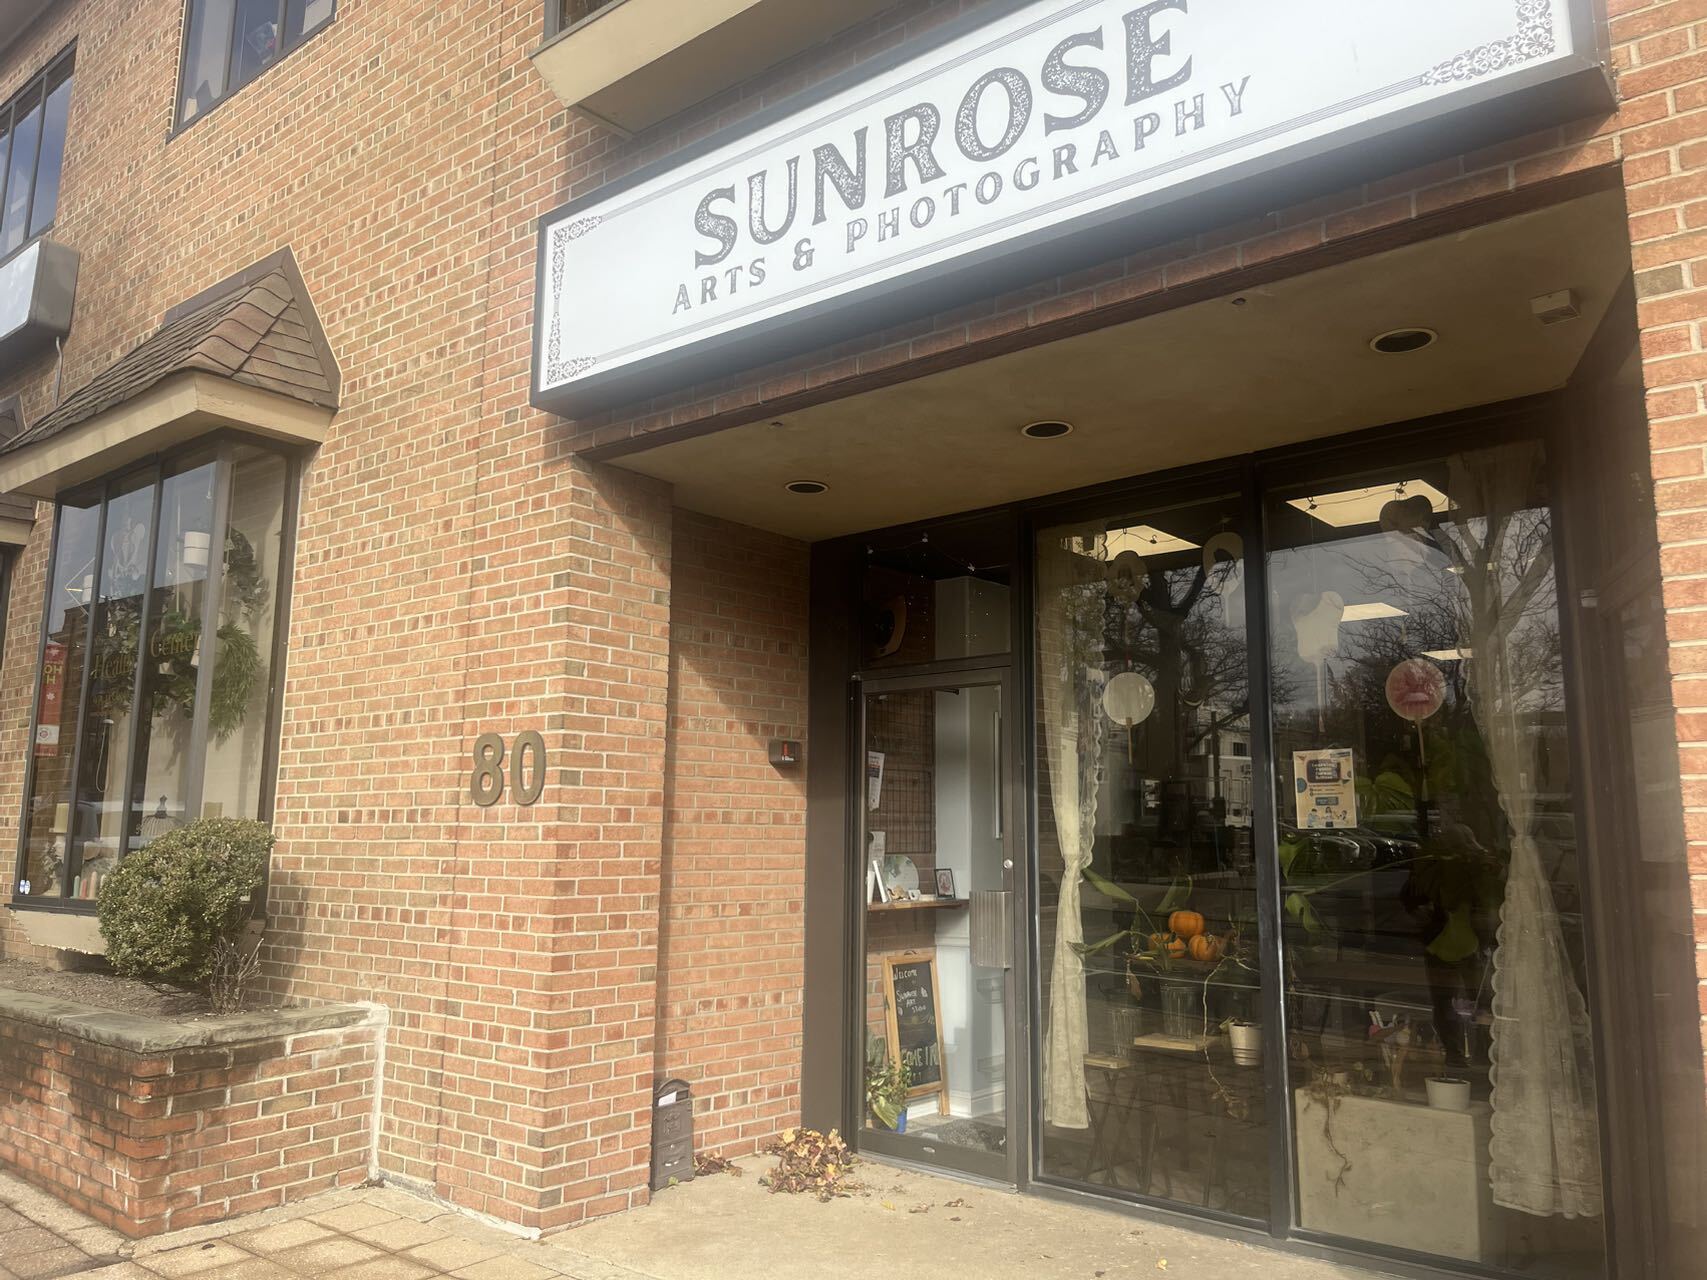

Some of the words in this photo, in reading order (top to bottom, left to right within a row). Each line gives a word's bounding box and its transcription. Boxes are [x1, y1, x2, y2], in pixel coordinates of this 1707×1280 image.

[672, 257, 767, 315] ARTS
[792, 236, 816, 273] &
[846, 75, 1252, 255] PHOTOGRAPHY
[694, 0, 1193, 270] SUNROSE
[470, 730, 546, 807] 80
